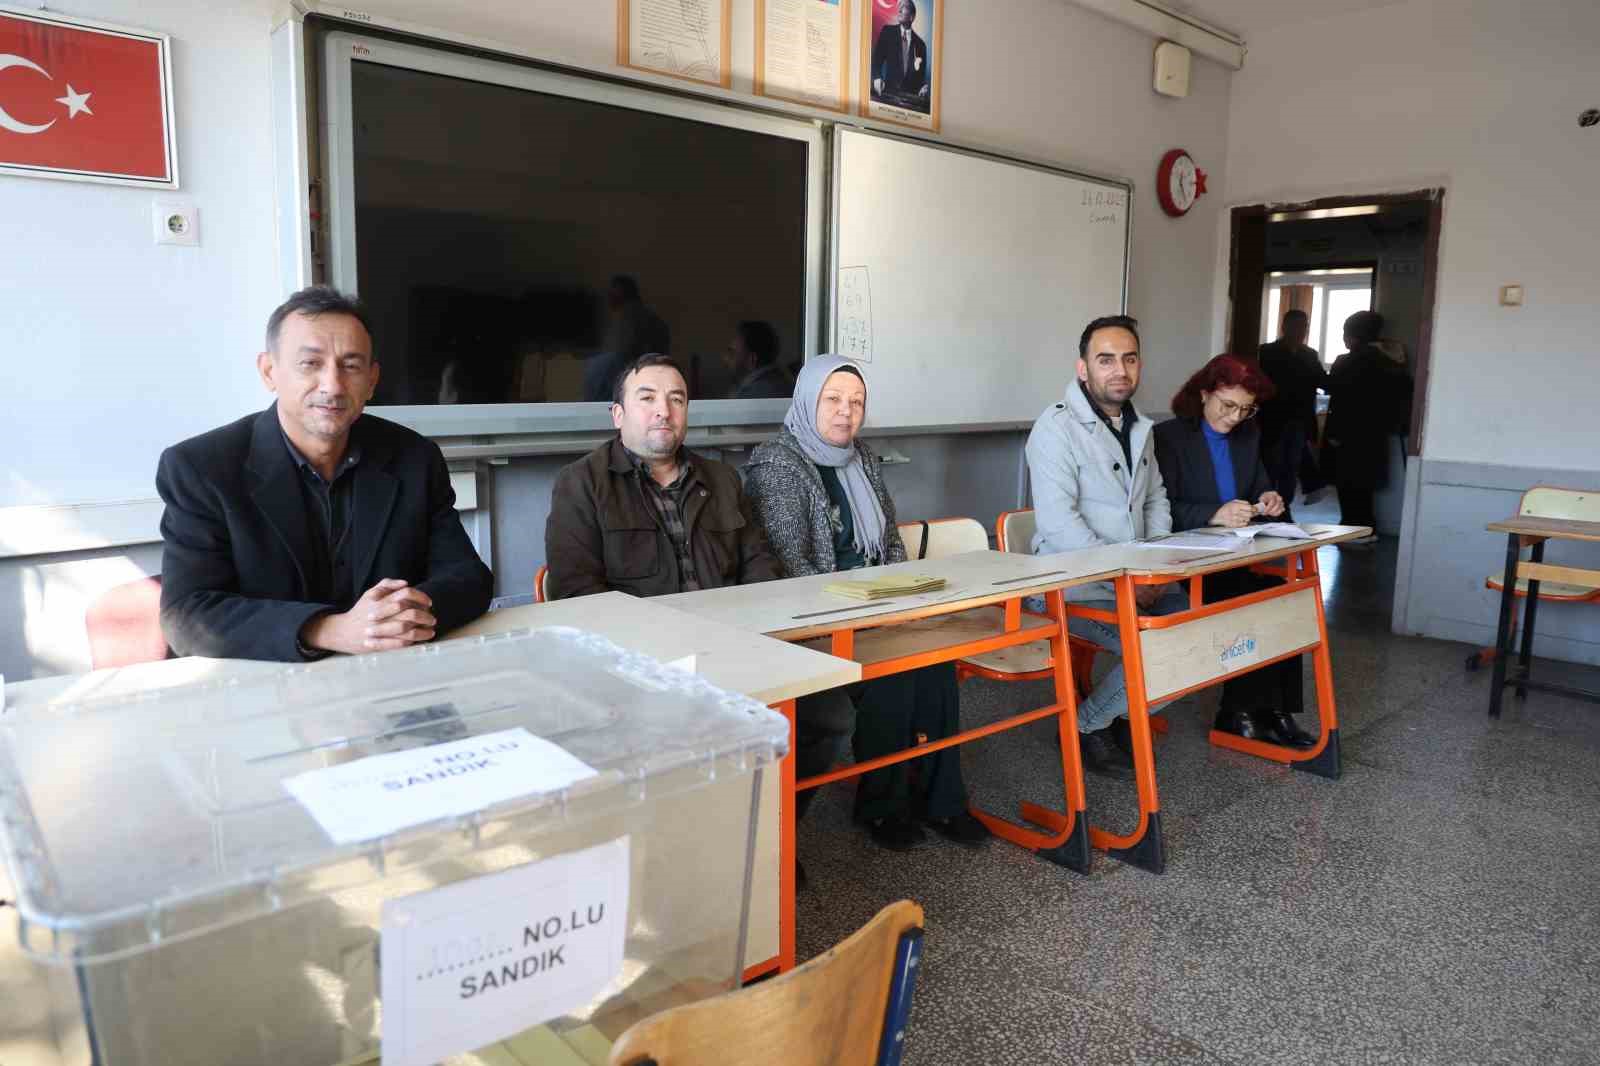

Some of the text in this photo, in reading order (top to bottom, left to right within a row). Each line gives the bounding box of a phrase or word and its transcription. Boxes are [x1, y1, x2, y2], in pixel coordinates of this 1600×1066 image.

[382, 759, 496, 791] SANDIK
[523, 902, 605, 946] NO.LU
[459, 944, 566, 998] SANDIK
